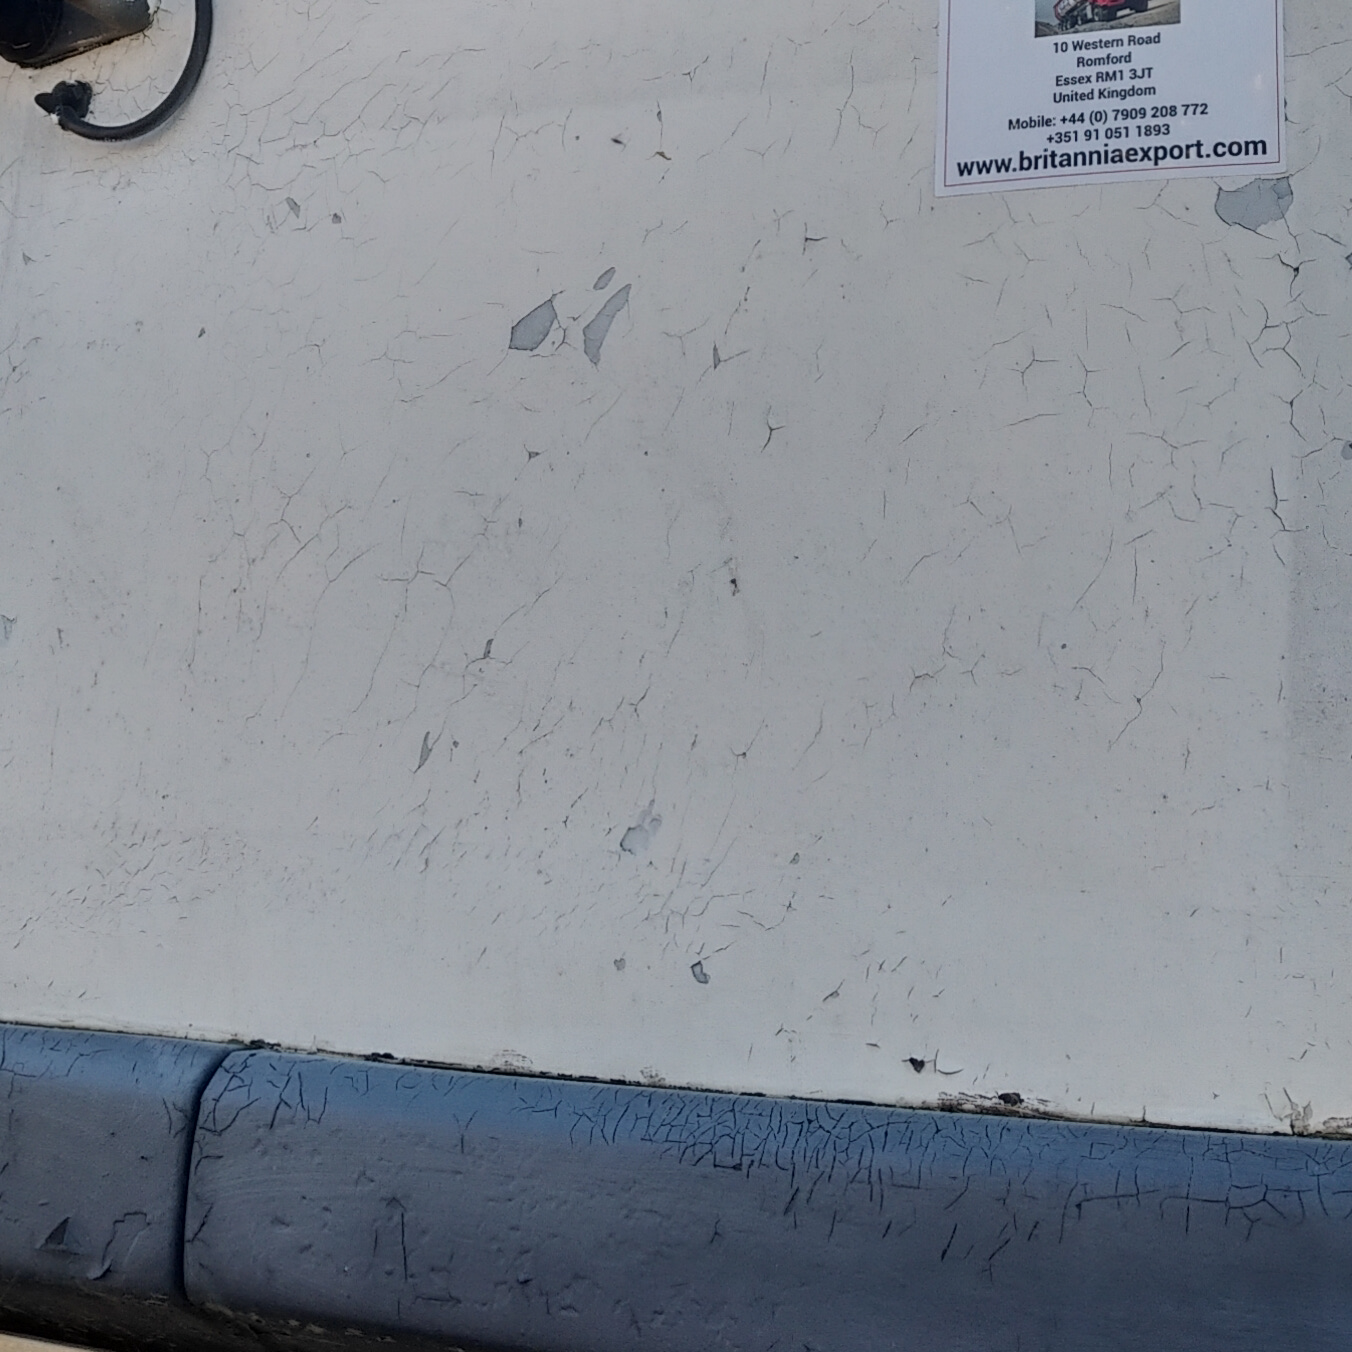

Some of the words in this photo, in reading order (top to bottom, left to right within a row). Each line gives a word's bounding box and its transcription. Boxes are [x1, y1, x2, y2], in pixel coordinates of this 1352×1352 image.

[1052, 41, 1069, 54] 10
[1071, 38, 1125, 52] Western
[1127, 32, 1161, 47] Road
[1076, 51, 1133, 68] Romford
[1055, 74, 1093, 87] Essex
[1095, 69, 1125, 84] RM1
[1128, 66, 1154, 80] 3JT
[1052, 88, 1095, 104] United
[1097, 84, 1157, 101] Kingdom
[1007, 114, 1058, 131] Mobile:
[1059, 111, 1086, 126] +44
[1088, 109, 1109, 127] (0)
[1111, 107, 1147, 122] 7909
[1150, 104, 1178, 119] 208
[1180, 102, 1209, 117] 772
[1046, 130, 1079, 145] +351
[1083, 128, 1101, 142] 91
[1104, 126, 1131, 141] 051
[1135, 123, 1171, 139] 1893
[956, 138, 1268, 178] www.britanniaexport.com
